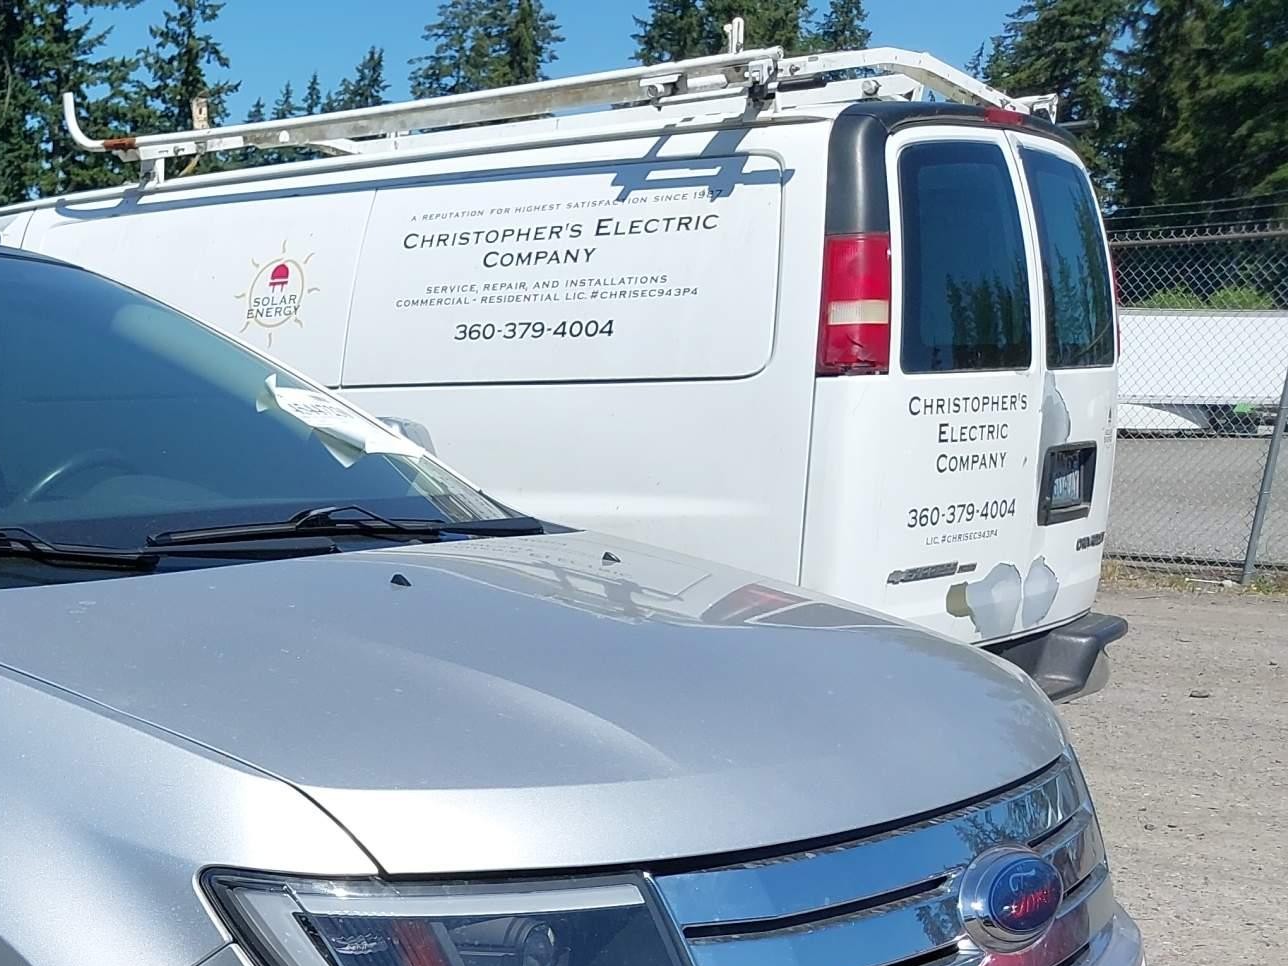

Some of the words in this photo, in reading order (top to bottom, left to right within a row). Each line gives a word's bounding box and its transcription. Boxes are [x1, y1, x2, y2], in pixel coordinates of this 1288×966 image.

[422, 209, 485, 221] REPUTATION
[489, 207, 510, 216] FOR
[514, 203, 561, 214] HIGHEST
[653, 193, 688, 203] SINCE
[403, 222, 583, 250] CHRISTOPHER'S
[594, 214, 719, 237] ELECTRIC
[483, 248, 596, 268] COMPANY
[425, 284, 479, 294] SERVICE,
[482, 281, 528, 292] REPAIR,
[532, 280, 559, 289] AND
[565, 275, 668, 287] INSTALLATIONS
[253, 294, 297, 307] SOLAR
[395, 296, 470, 308] COMMERCIAL
[480, 293, 560, 304] RESIDENTIAL
[565, 291, 587, 300] LIC.
[247, 305, 300, 319] ENERGY
[454, 319, 614, 341] 360-379-4004
[908, 392, 1028, 416] CHRISTOPHER'S
[938, 423, 1009, 443] ELECTRIC
[936, 452, 1007, 473] COMPANY
[907, 498, 1016, 528] 360-379-4004
